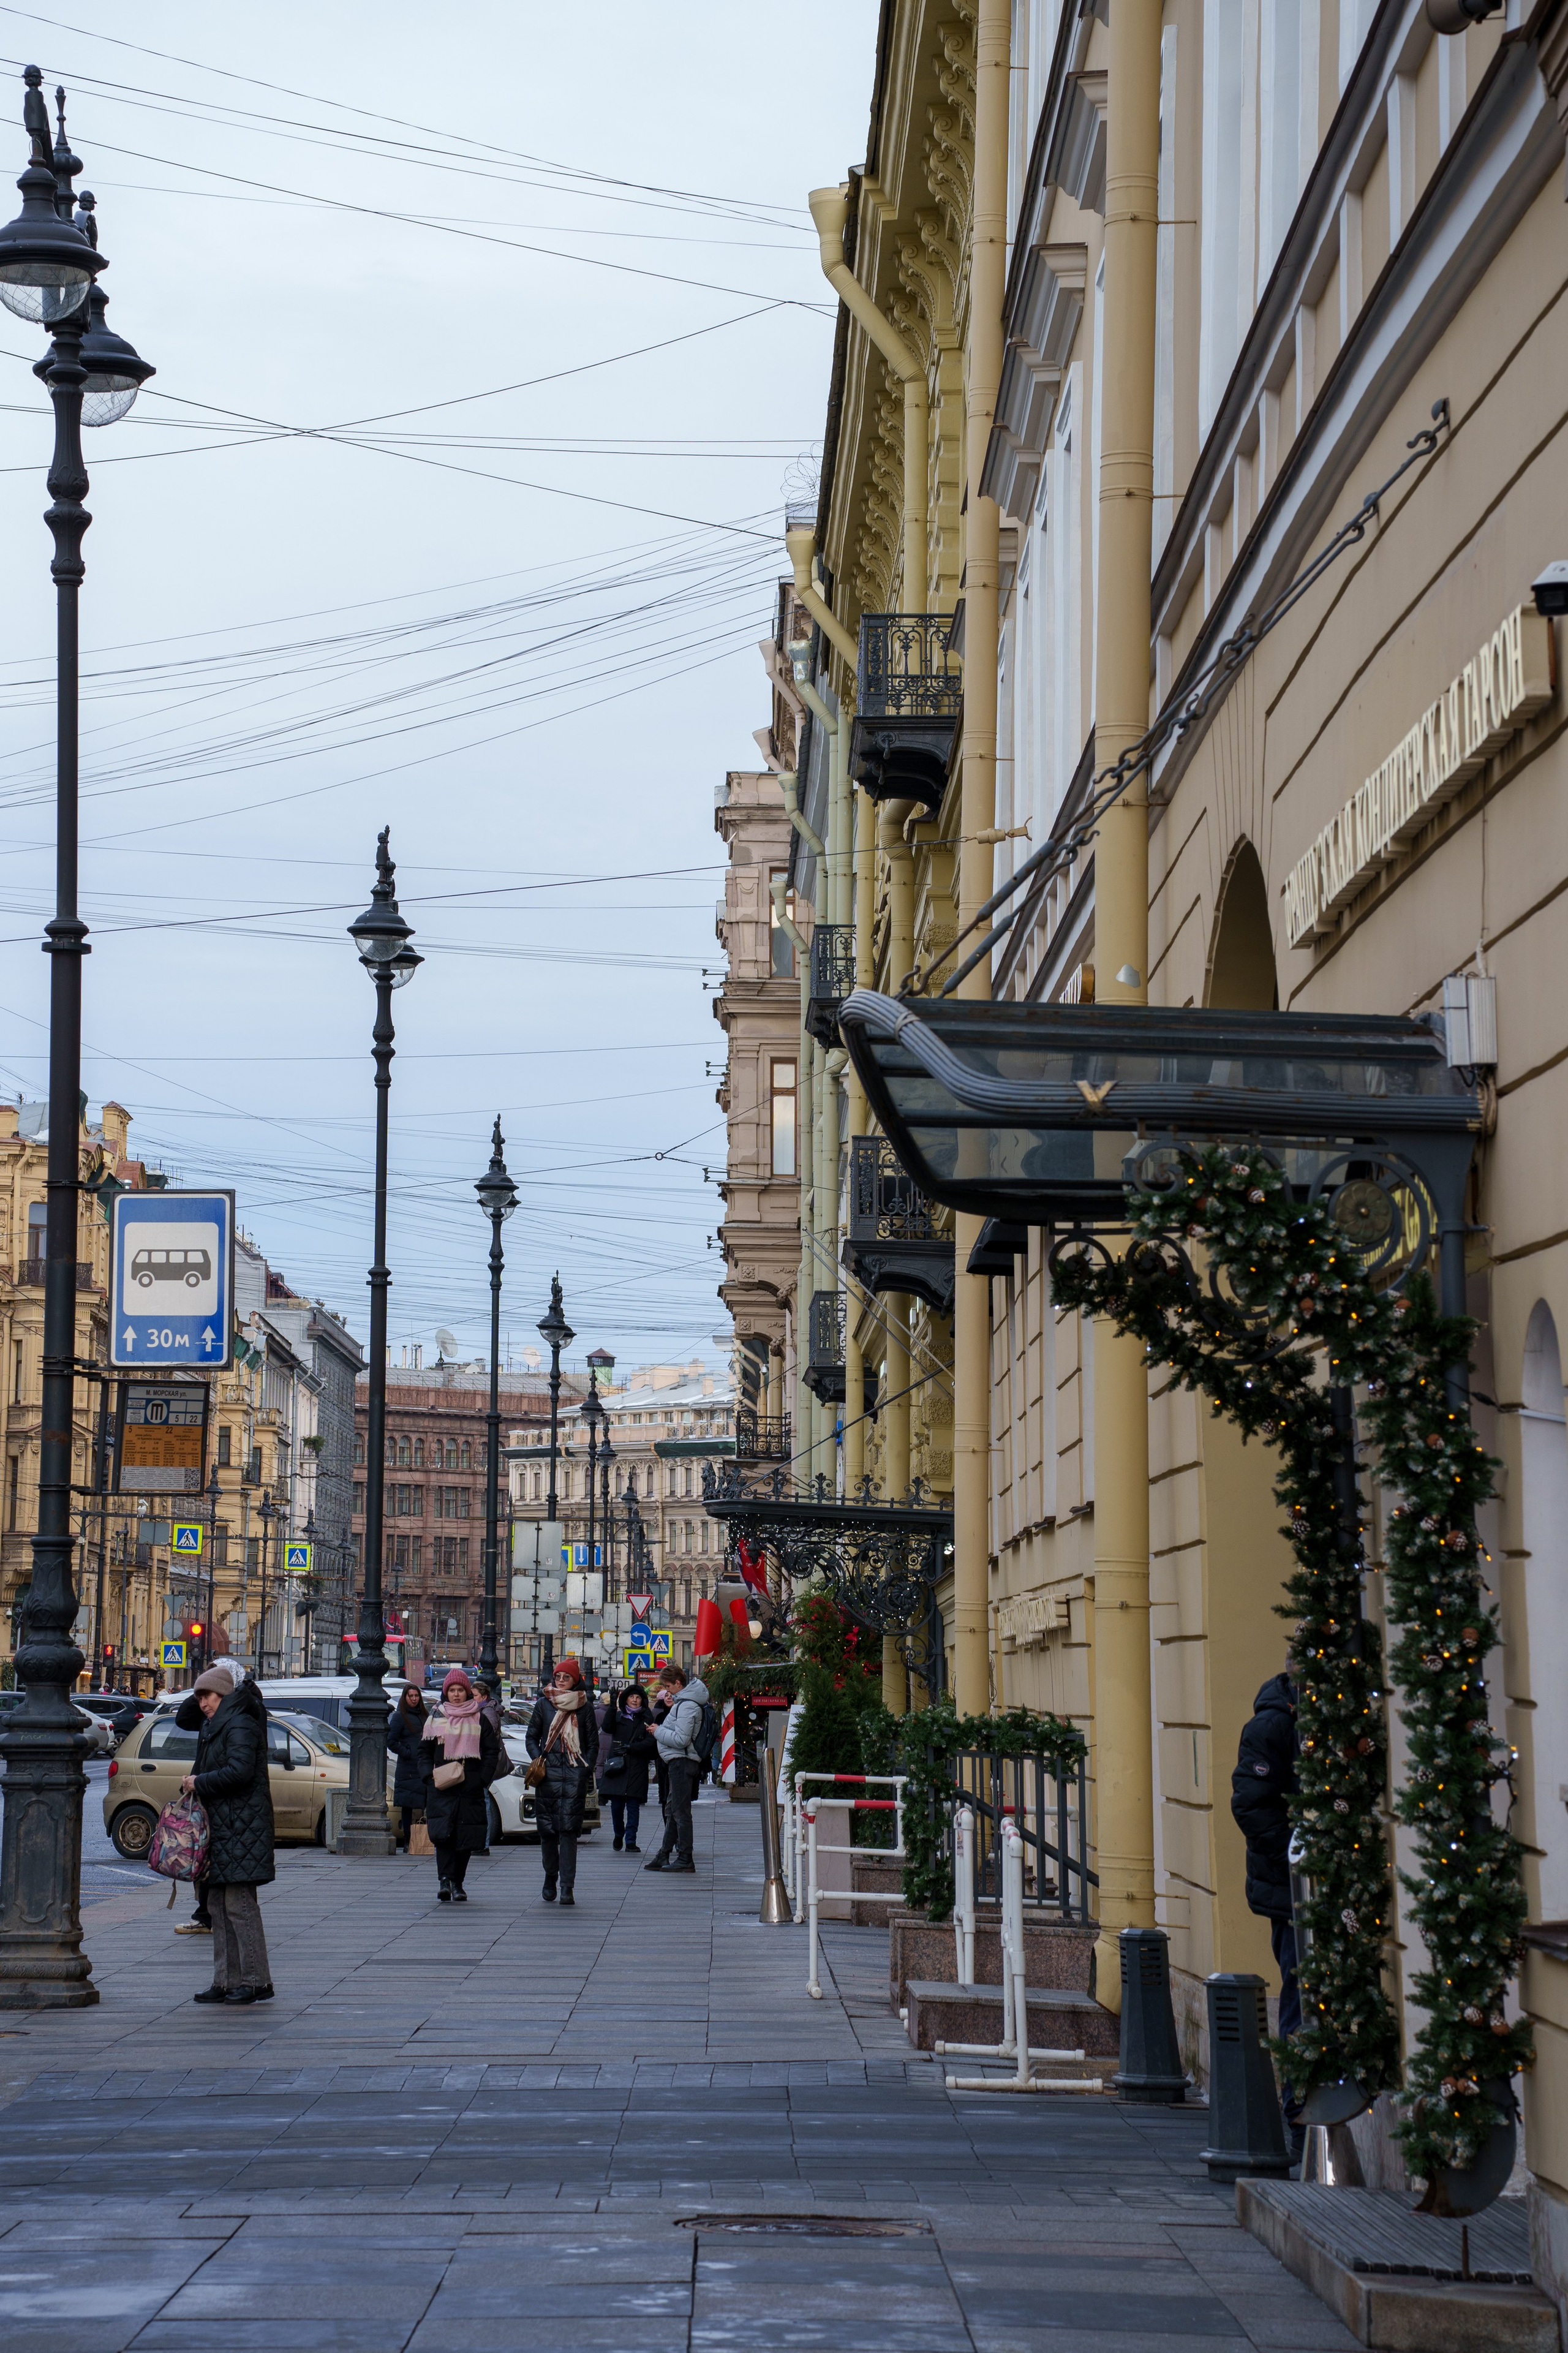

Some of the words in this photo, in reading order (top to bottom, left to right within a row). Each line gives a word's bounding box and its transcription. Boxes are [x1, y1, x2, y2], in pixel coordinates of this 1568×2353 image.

[1284, 799, 1354, 950] ФРАНЦУЗСКАЯ
[1355, 676, 1461, 872] КОНДИТЕРСКАЯ
[1463, 603, 1526, 758] ГАРСОН
[147, 1329, 189, 1348] 30м
[606, 1680, 630, 1688] СТОП
